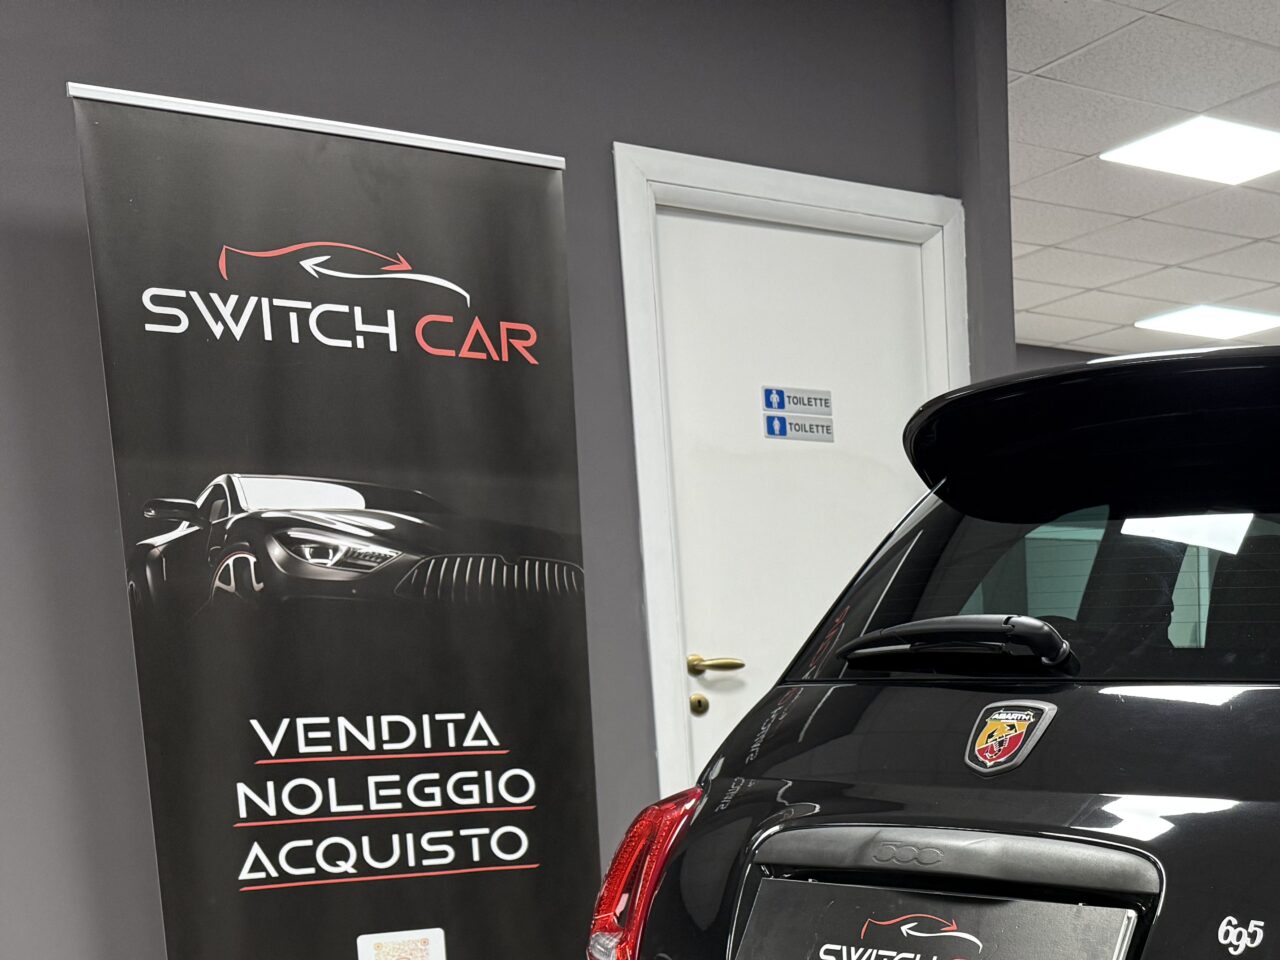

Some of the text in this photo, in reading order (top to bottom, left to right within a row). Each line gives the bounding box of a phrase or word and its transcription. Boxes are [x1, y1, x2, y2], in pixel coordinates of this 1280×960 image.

[142, 286, 540, 365] SWITCH CAR
[786, 395, 831, 408] TOILETTE
[788, 422, 832, 435] TOILETTE
[249, 710, 500, 757] VENDITA
[236, 768, 536, 818] NOLEGGIO
[238, 825, 529, 880] ACQUISTO
[872, 841, 944, 867] 500
[1218, 916, 1264, 955] 695
